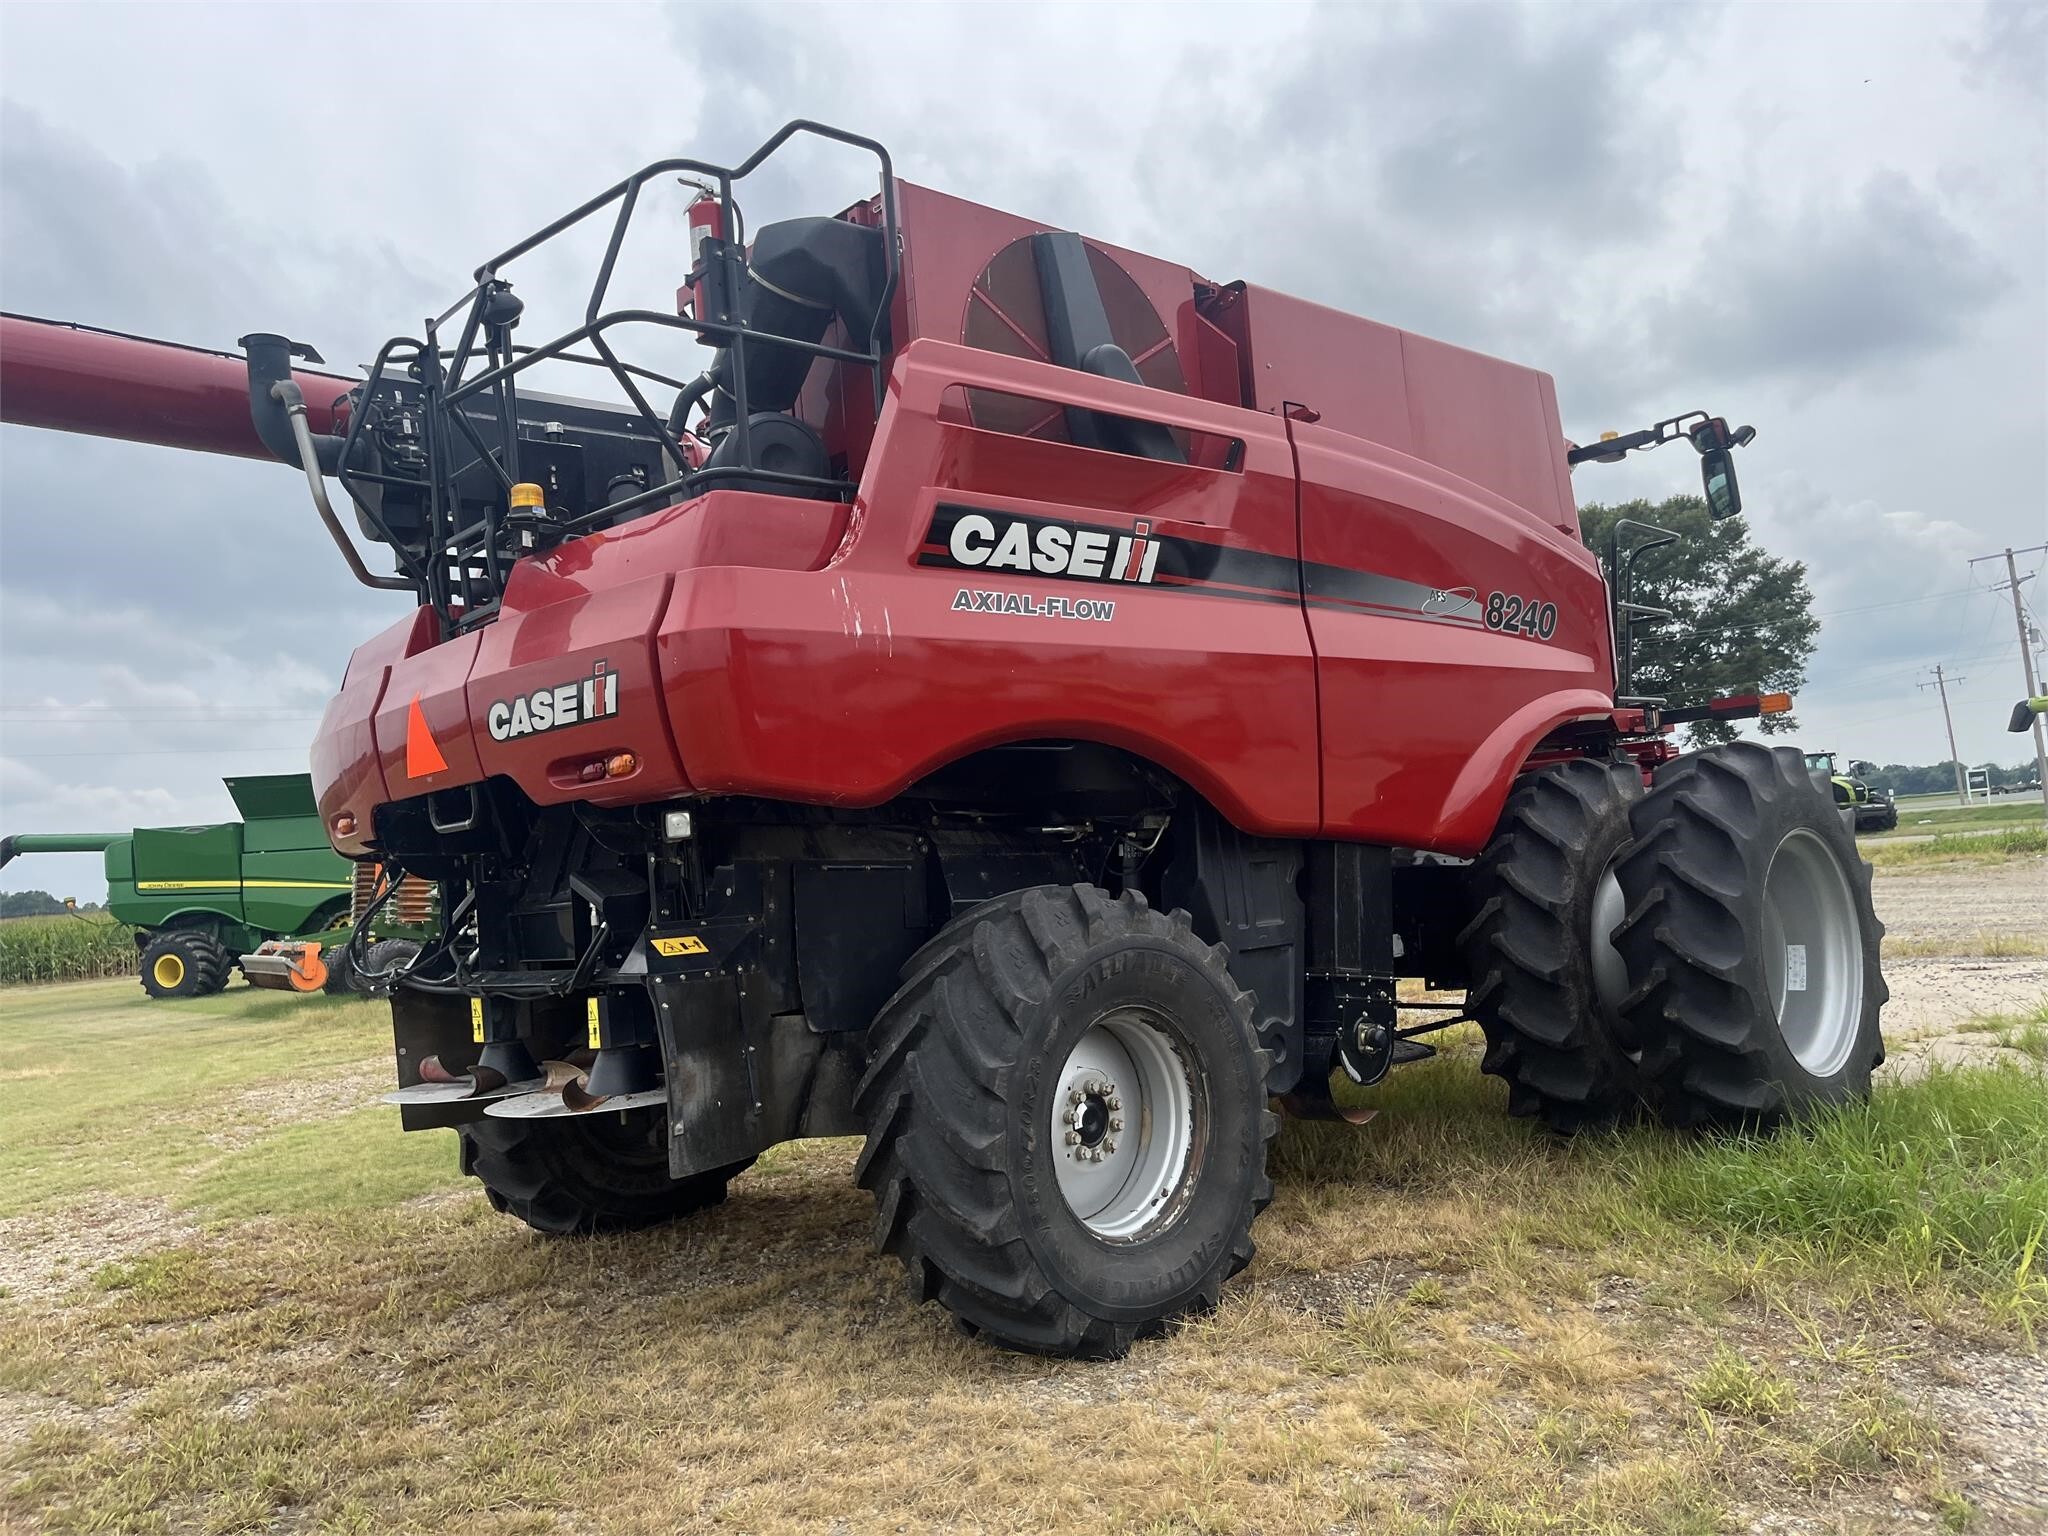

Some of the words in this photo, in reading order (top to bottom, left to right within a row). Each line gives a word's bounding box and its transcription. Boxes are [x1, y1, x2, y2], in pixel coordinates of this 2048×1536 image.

[950, 514, 1109, 577] CASE
[951, 588, 1115, 622] AXIAL-FLOW
[1429, 589, 1448, 603] AFS
[1485, 591, 1558, 640] 8240
[488, 683, 578, 741] CASE
